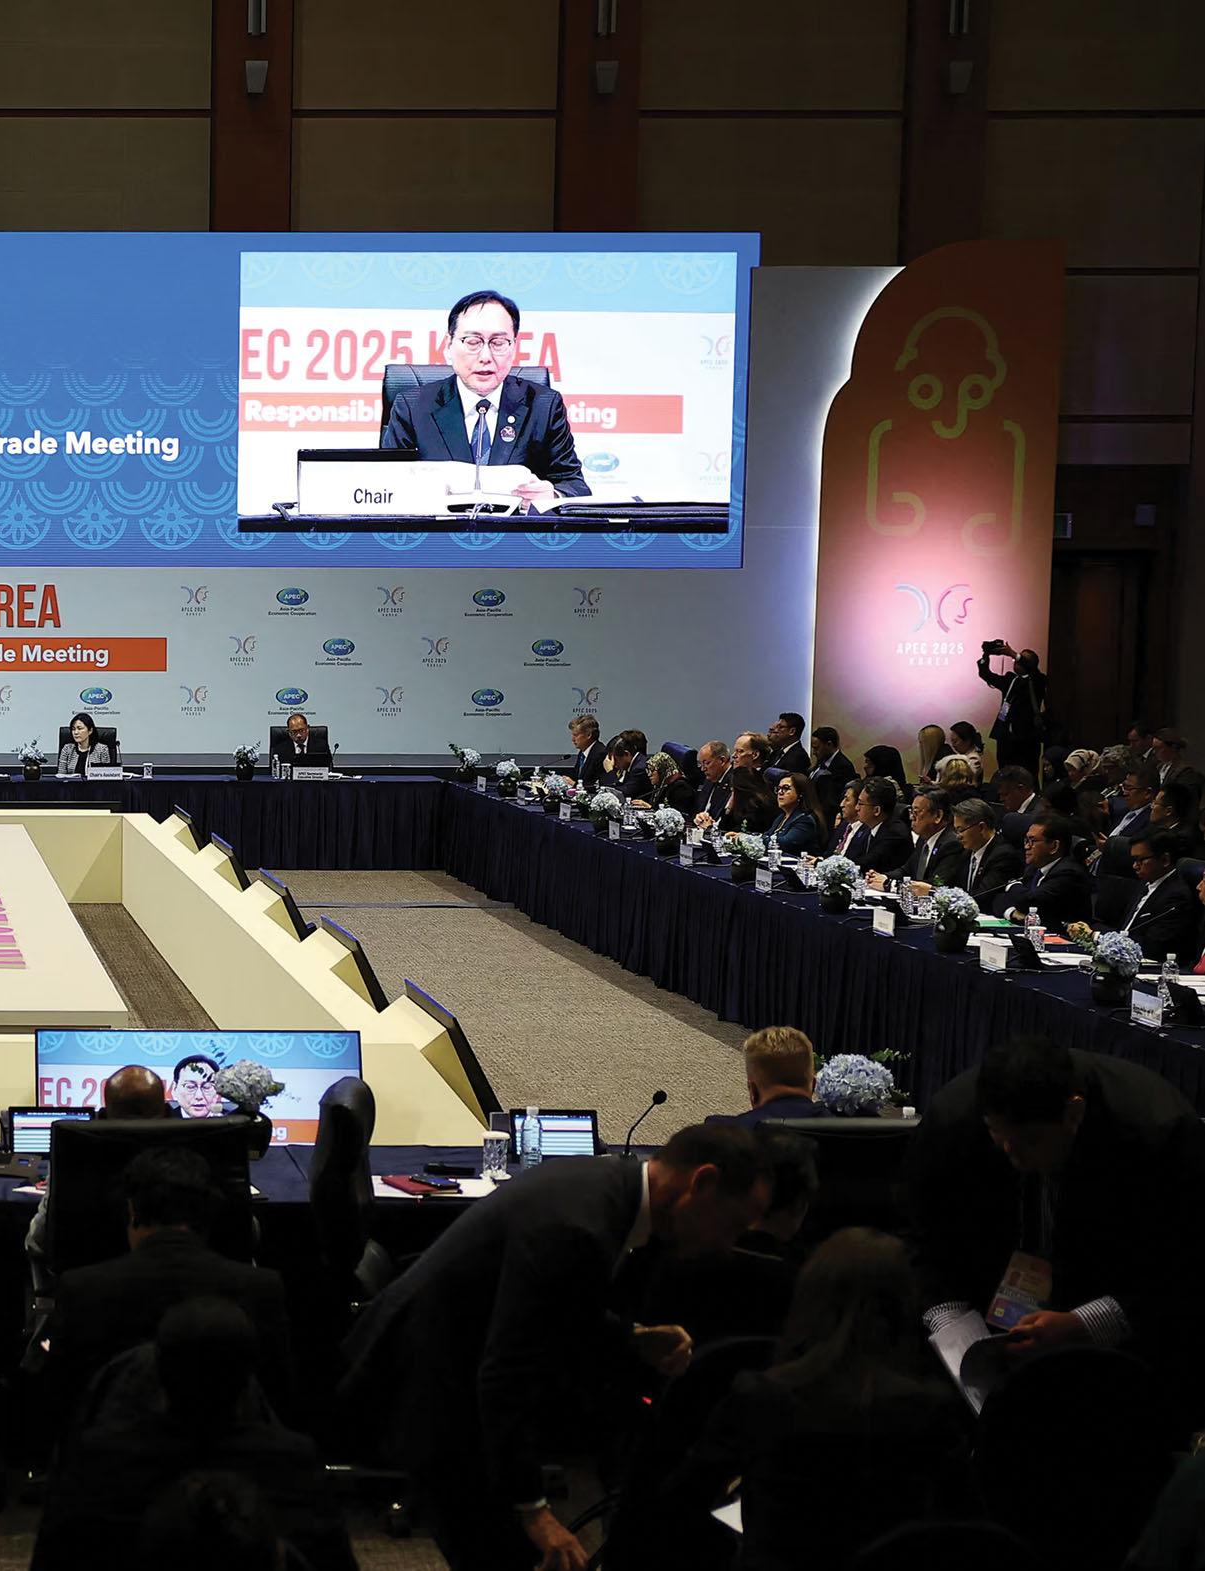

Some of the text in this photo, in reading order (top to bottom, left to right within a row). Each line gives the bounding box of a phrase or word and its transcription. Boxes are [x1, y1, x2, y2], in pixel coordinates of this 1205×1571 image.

[241, 329, 562, 382] EC 2025 KEA
[245, 400, 381, 428] Responsibl
[568, 402, 617, 429] ting
[65, 431, 179, 461] Meeting
[353, 488, 394, 505] Chair
[22, 645, 109, 668] Meeting
[896, 642, 964, 655] APEC 2025
[40, 1077, 71, 1107] EC
